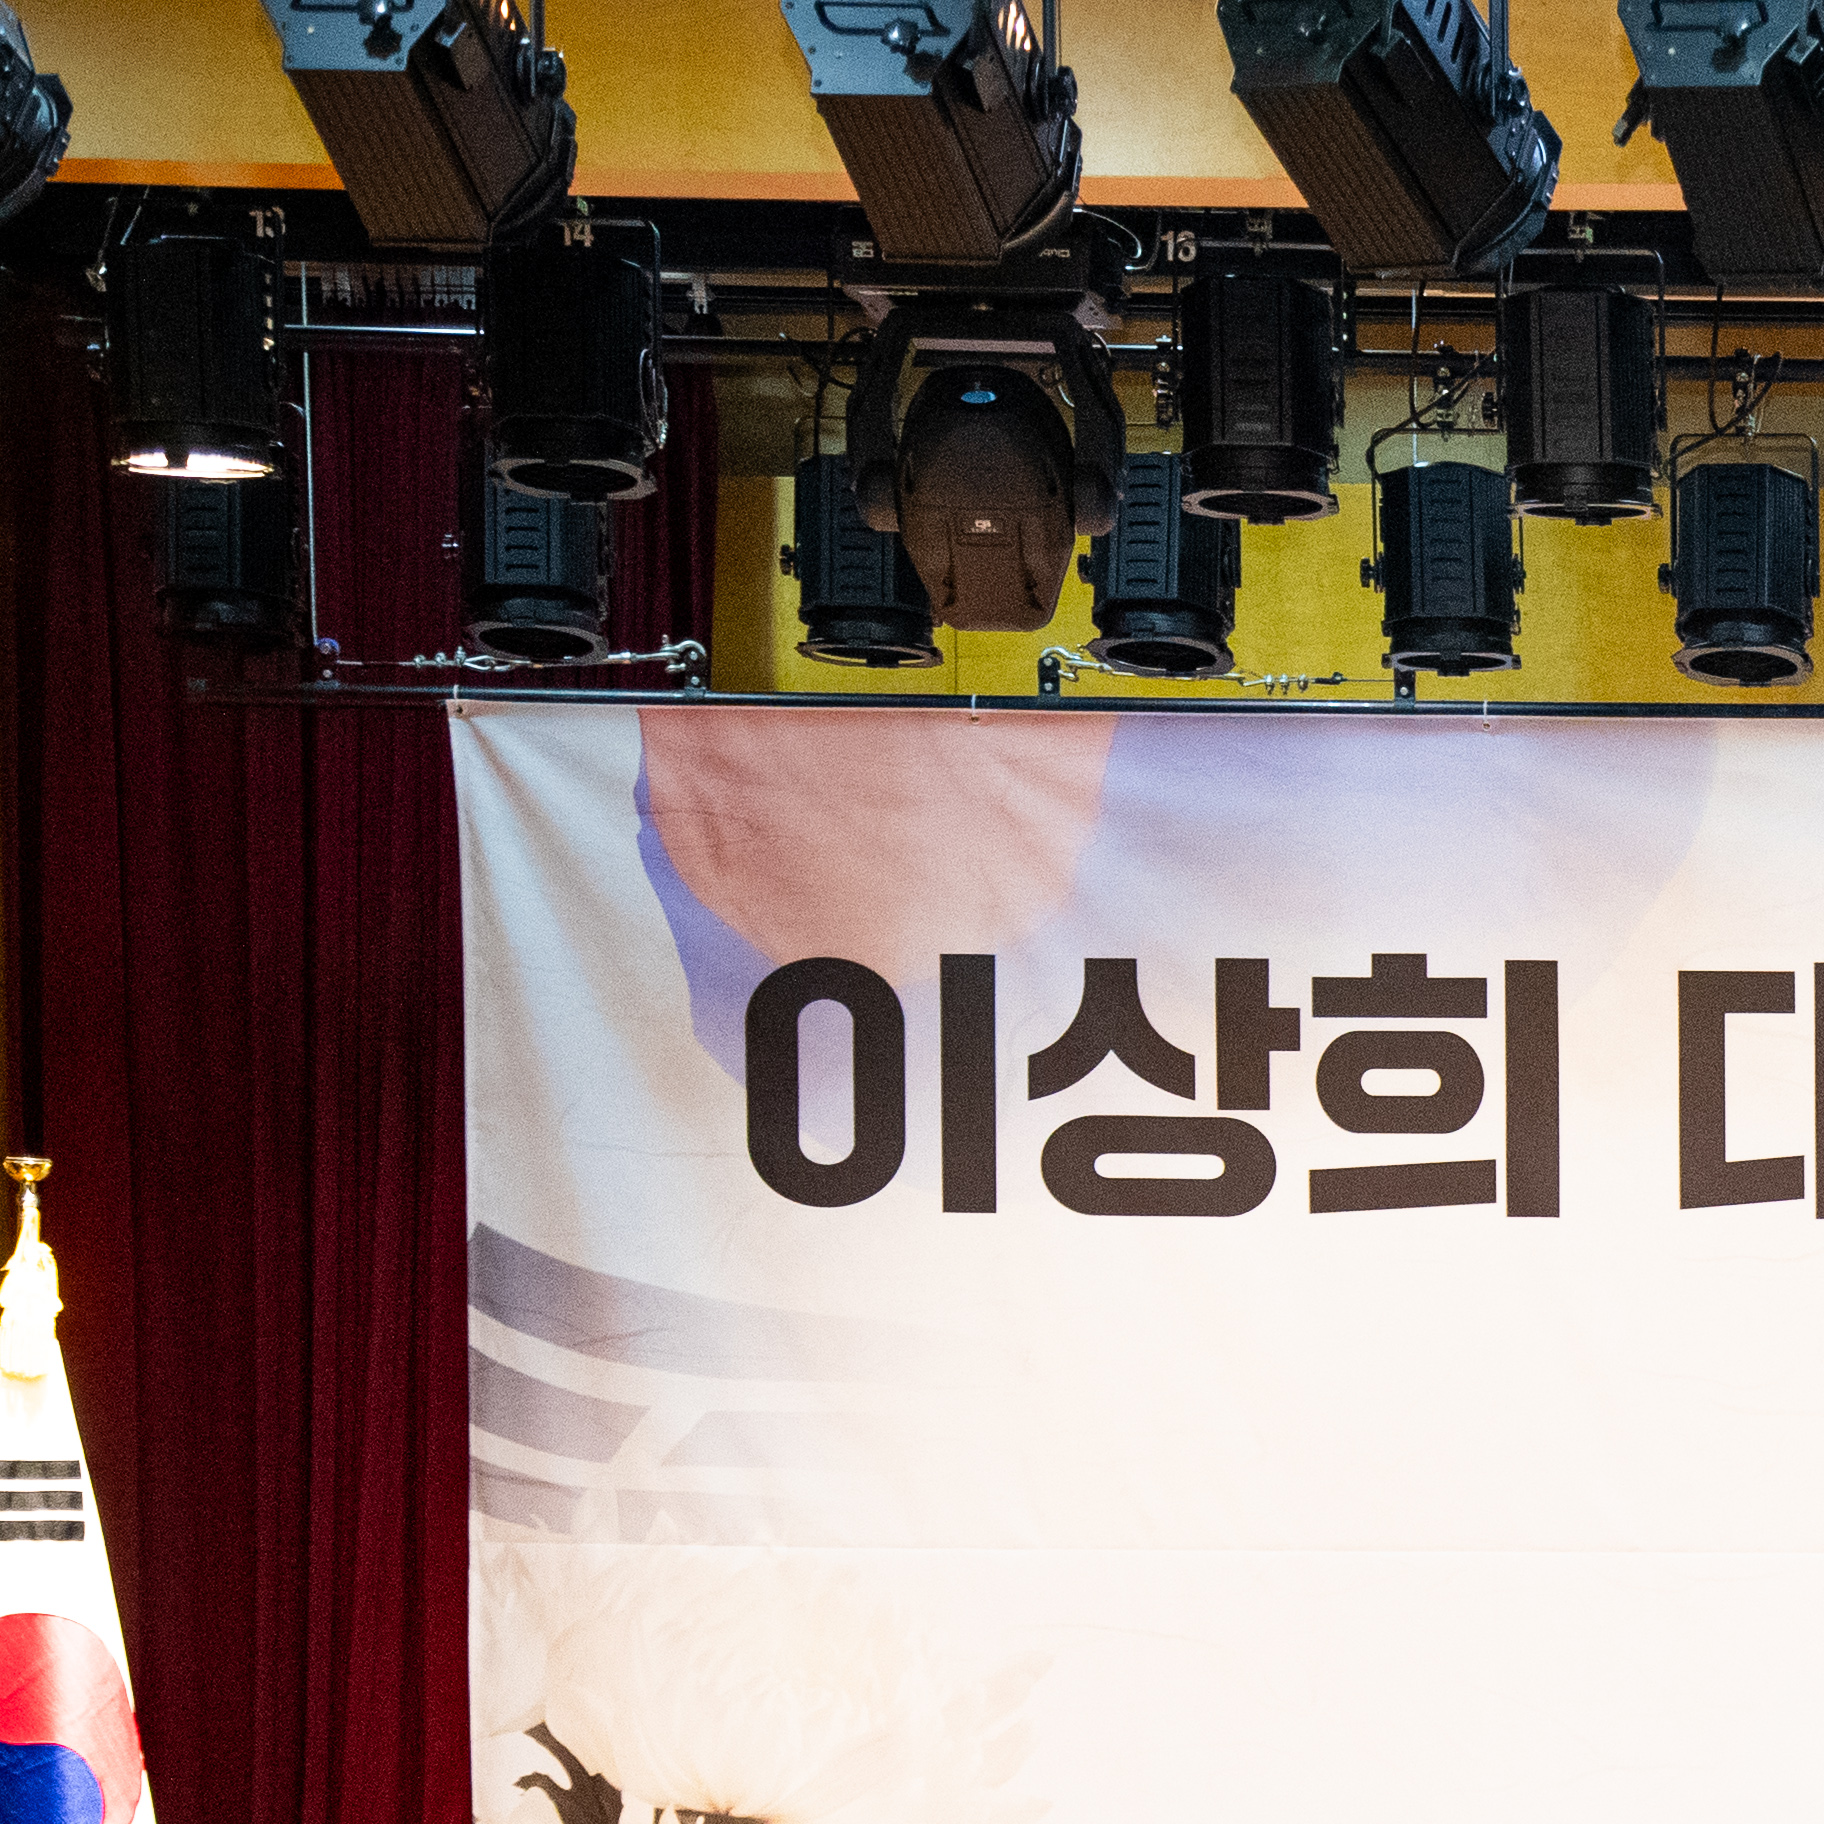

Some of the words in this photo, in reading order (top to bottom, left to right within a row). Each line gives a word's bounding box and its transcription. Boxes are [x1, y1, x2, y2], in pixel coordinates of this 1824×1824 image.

[562, 218, 595, 248] 14
[1160, 230, 1197, 262] 16
[745, 954, 1558, 1216] 이상희
